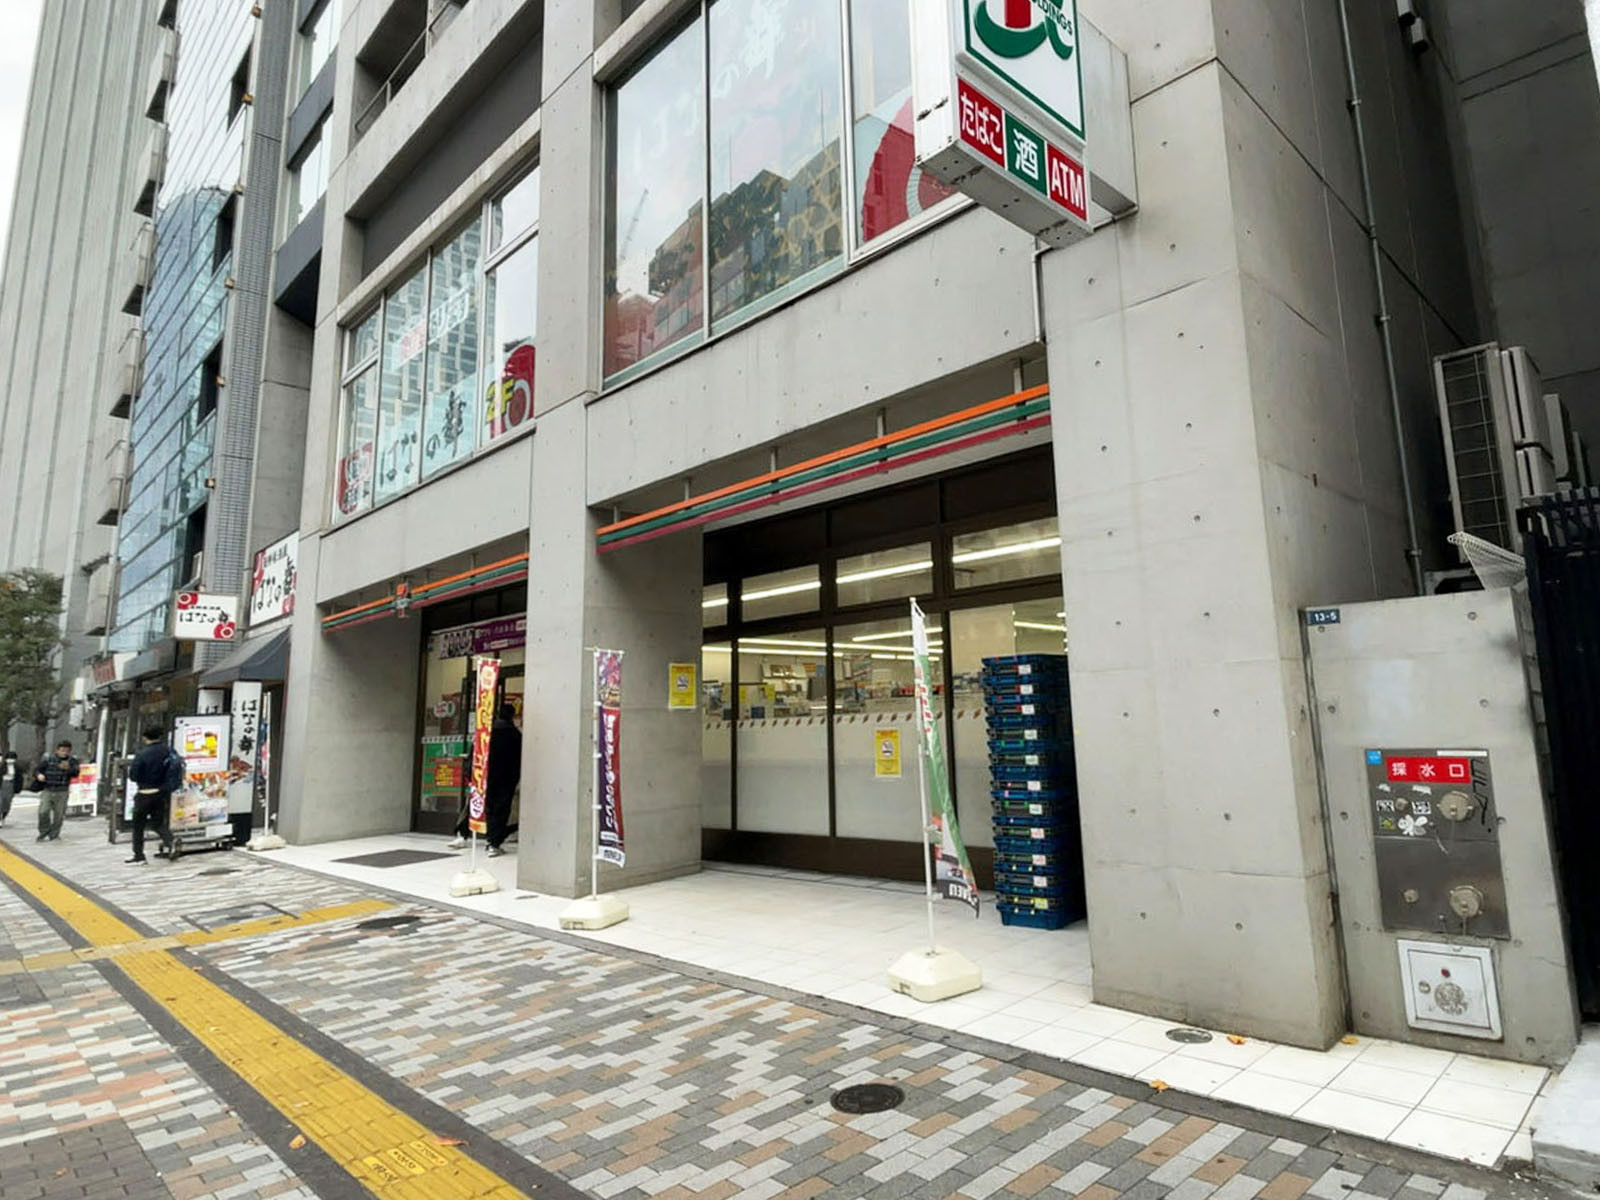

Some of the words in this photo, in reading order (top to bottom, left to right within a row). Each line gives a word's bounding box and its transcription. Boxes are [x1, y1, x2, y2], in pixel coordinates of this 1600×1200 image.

[960, 92, 1003, 156] たばこ
[1013, 128, 1039, 182] 酒
[1051, 157, 1085, 212] ATM
[238, 699, 258, 756] はなの舞
[1391, 762, 1465, 777] 採水口
